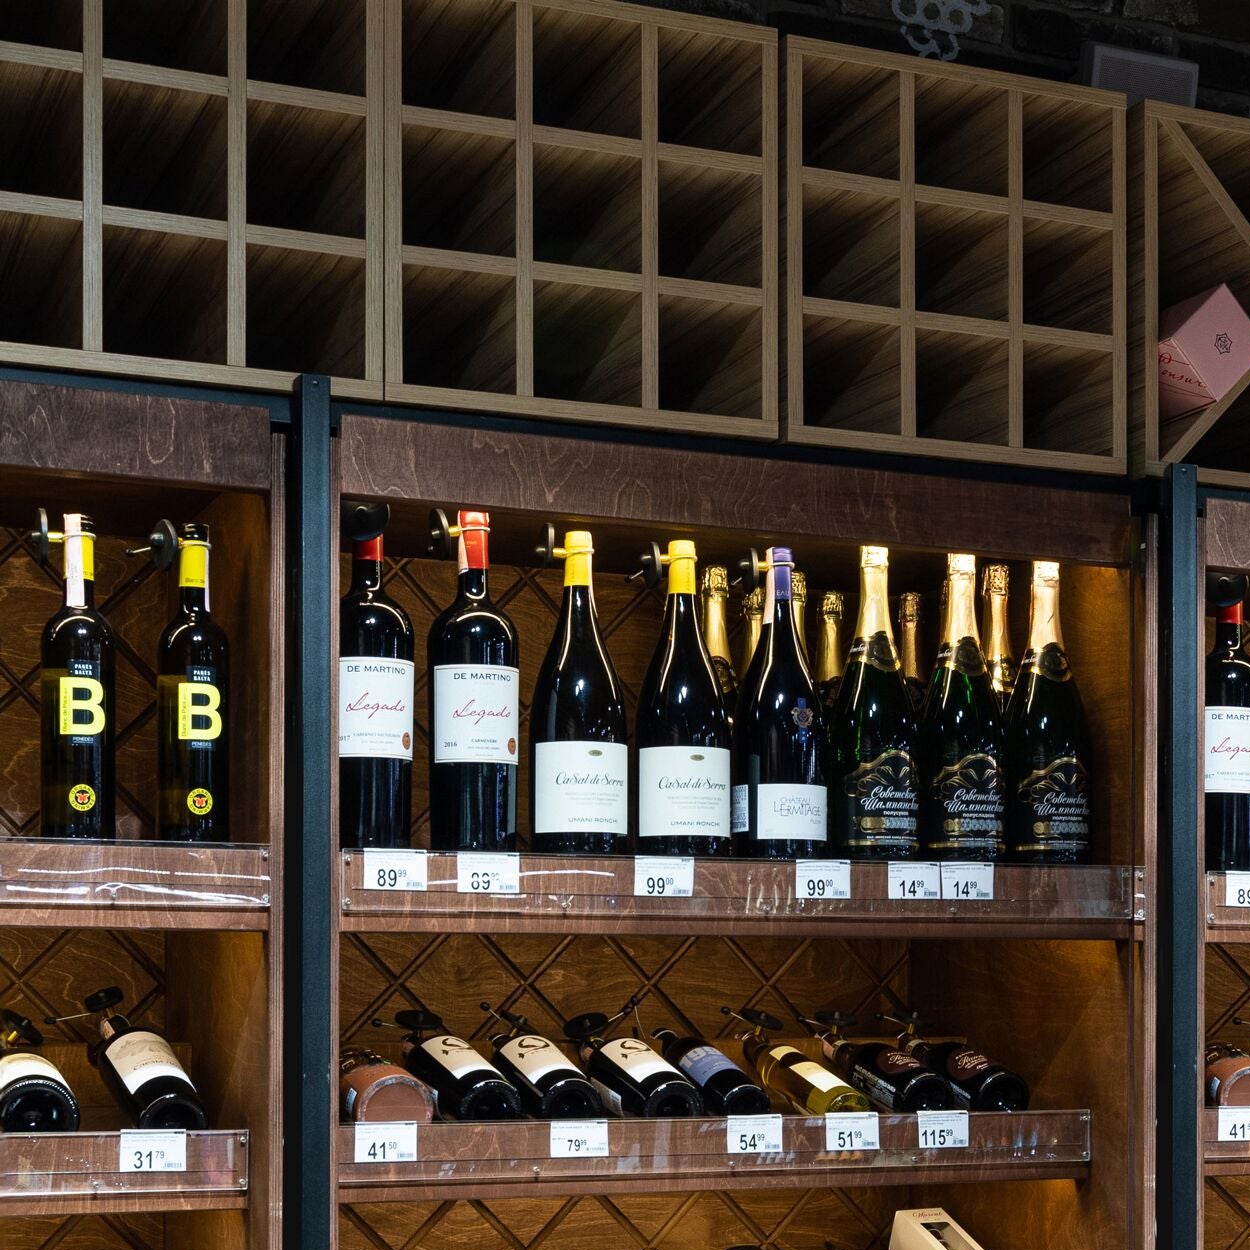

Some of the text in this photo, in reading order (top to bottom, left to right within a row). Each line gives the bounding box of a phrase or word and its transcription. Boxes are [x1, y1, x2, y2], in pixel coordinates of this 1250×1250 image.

[347, 665, 406, 675] DE MARTINO
[453, 672, 512, 682] DE MARTINO
[60, 677, 105, 735] B
[178, 682, 222, 740] B
[345, 692, 405, 719] Legado
